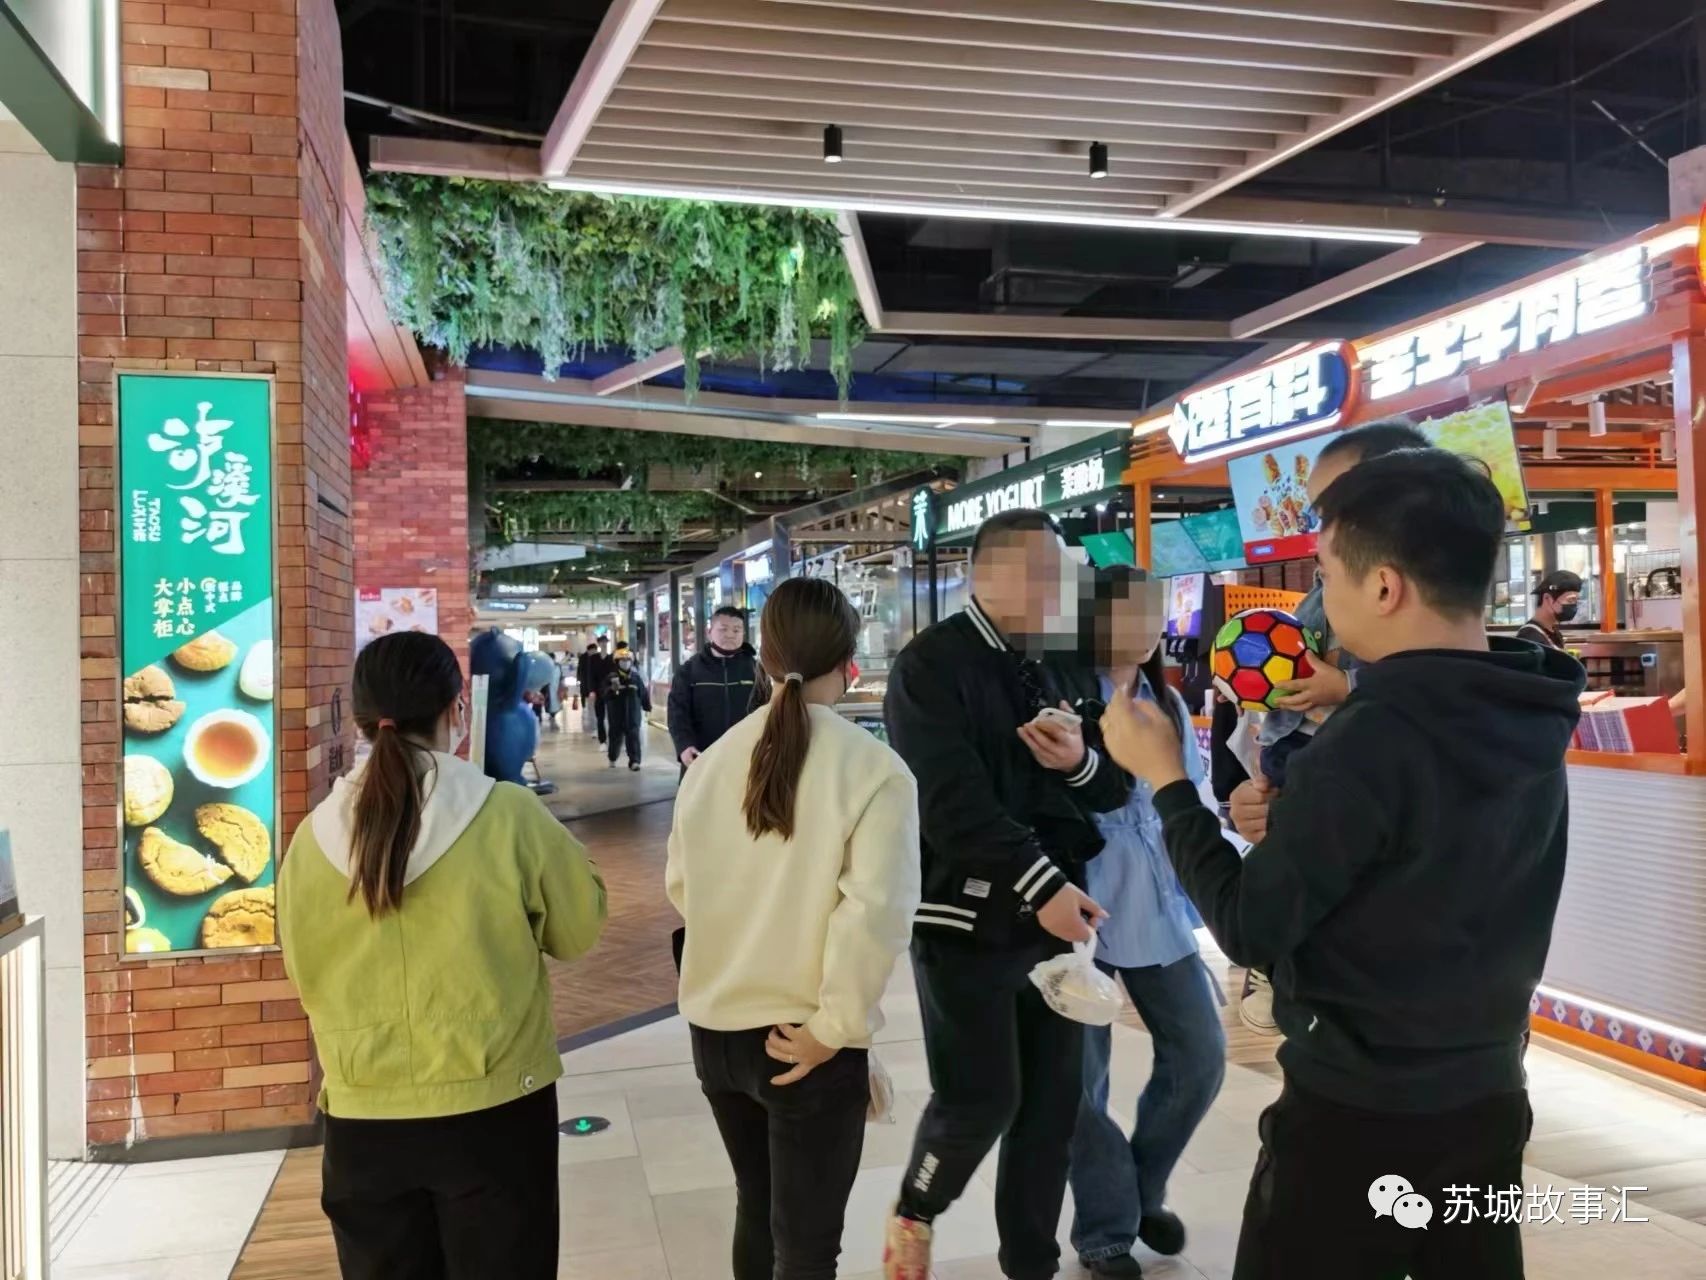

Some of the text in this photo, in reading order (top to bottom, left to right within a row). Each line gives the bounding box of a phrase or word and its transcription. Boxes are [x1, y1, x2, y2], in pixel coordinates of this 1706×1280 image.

[132, 490, 149, 542] LUXIHE
[148, 498, 161, 542] TAOSU
[153, 578, 175, 639] 大掌柜
[176, 577, 196, 636] 小点心
